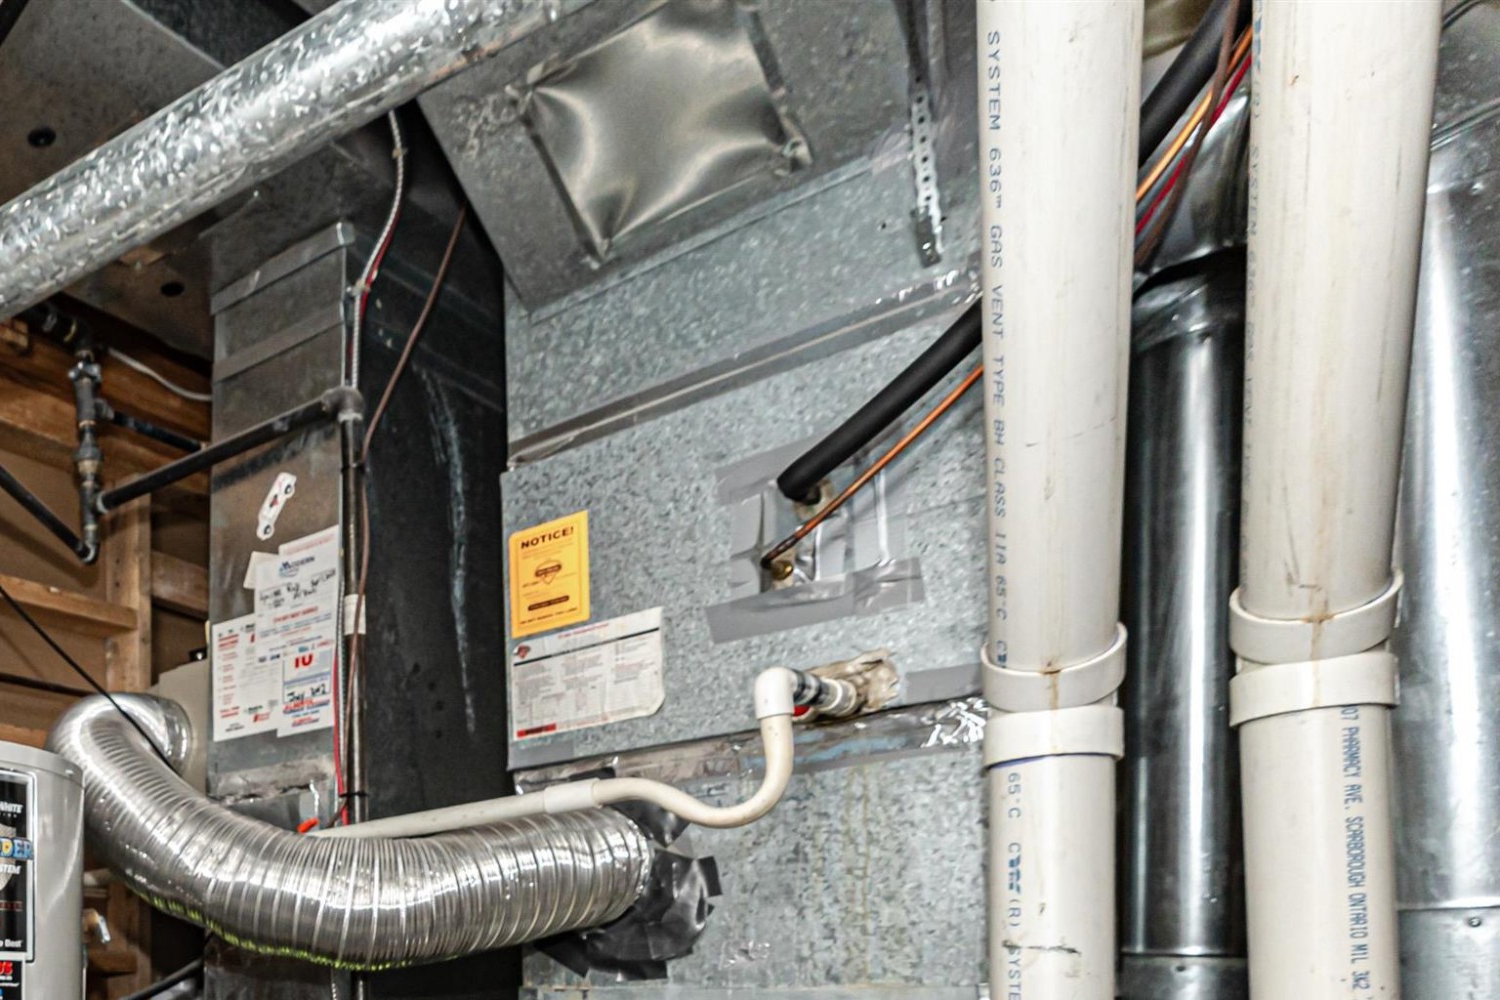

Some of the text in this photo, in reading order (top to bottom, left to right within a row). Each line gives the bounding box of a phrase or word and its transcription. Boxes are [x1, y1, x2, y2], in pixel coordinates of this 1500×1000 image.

[986, 30, 1001, 131] SYSTEM
[990, 225, 1003, 269] GAS
[991, 284, 1004, 339] VENT
[992, 355, 1005, 407] TYPE
[993, 419, 1005, 446] BH
[994, 457, 1007, 519] CLASS
[520, 525, 574, 550] NOTICE!
[1341, 726, 1361, 778] PHARMACY
[1345, 816, 1366, 888] SCARBOROUGH
[1348, 892, 1368, 939] ONTARIO
